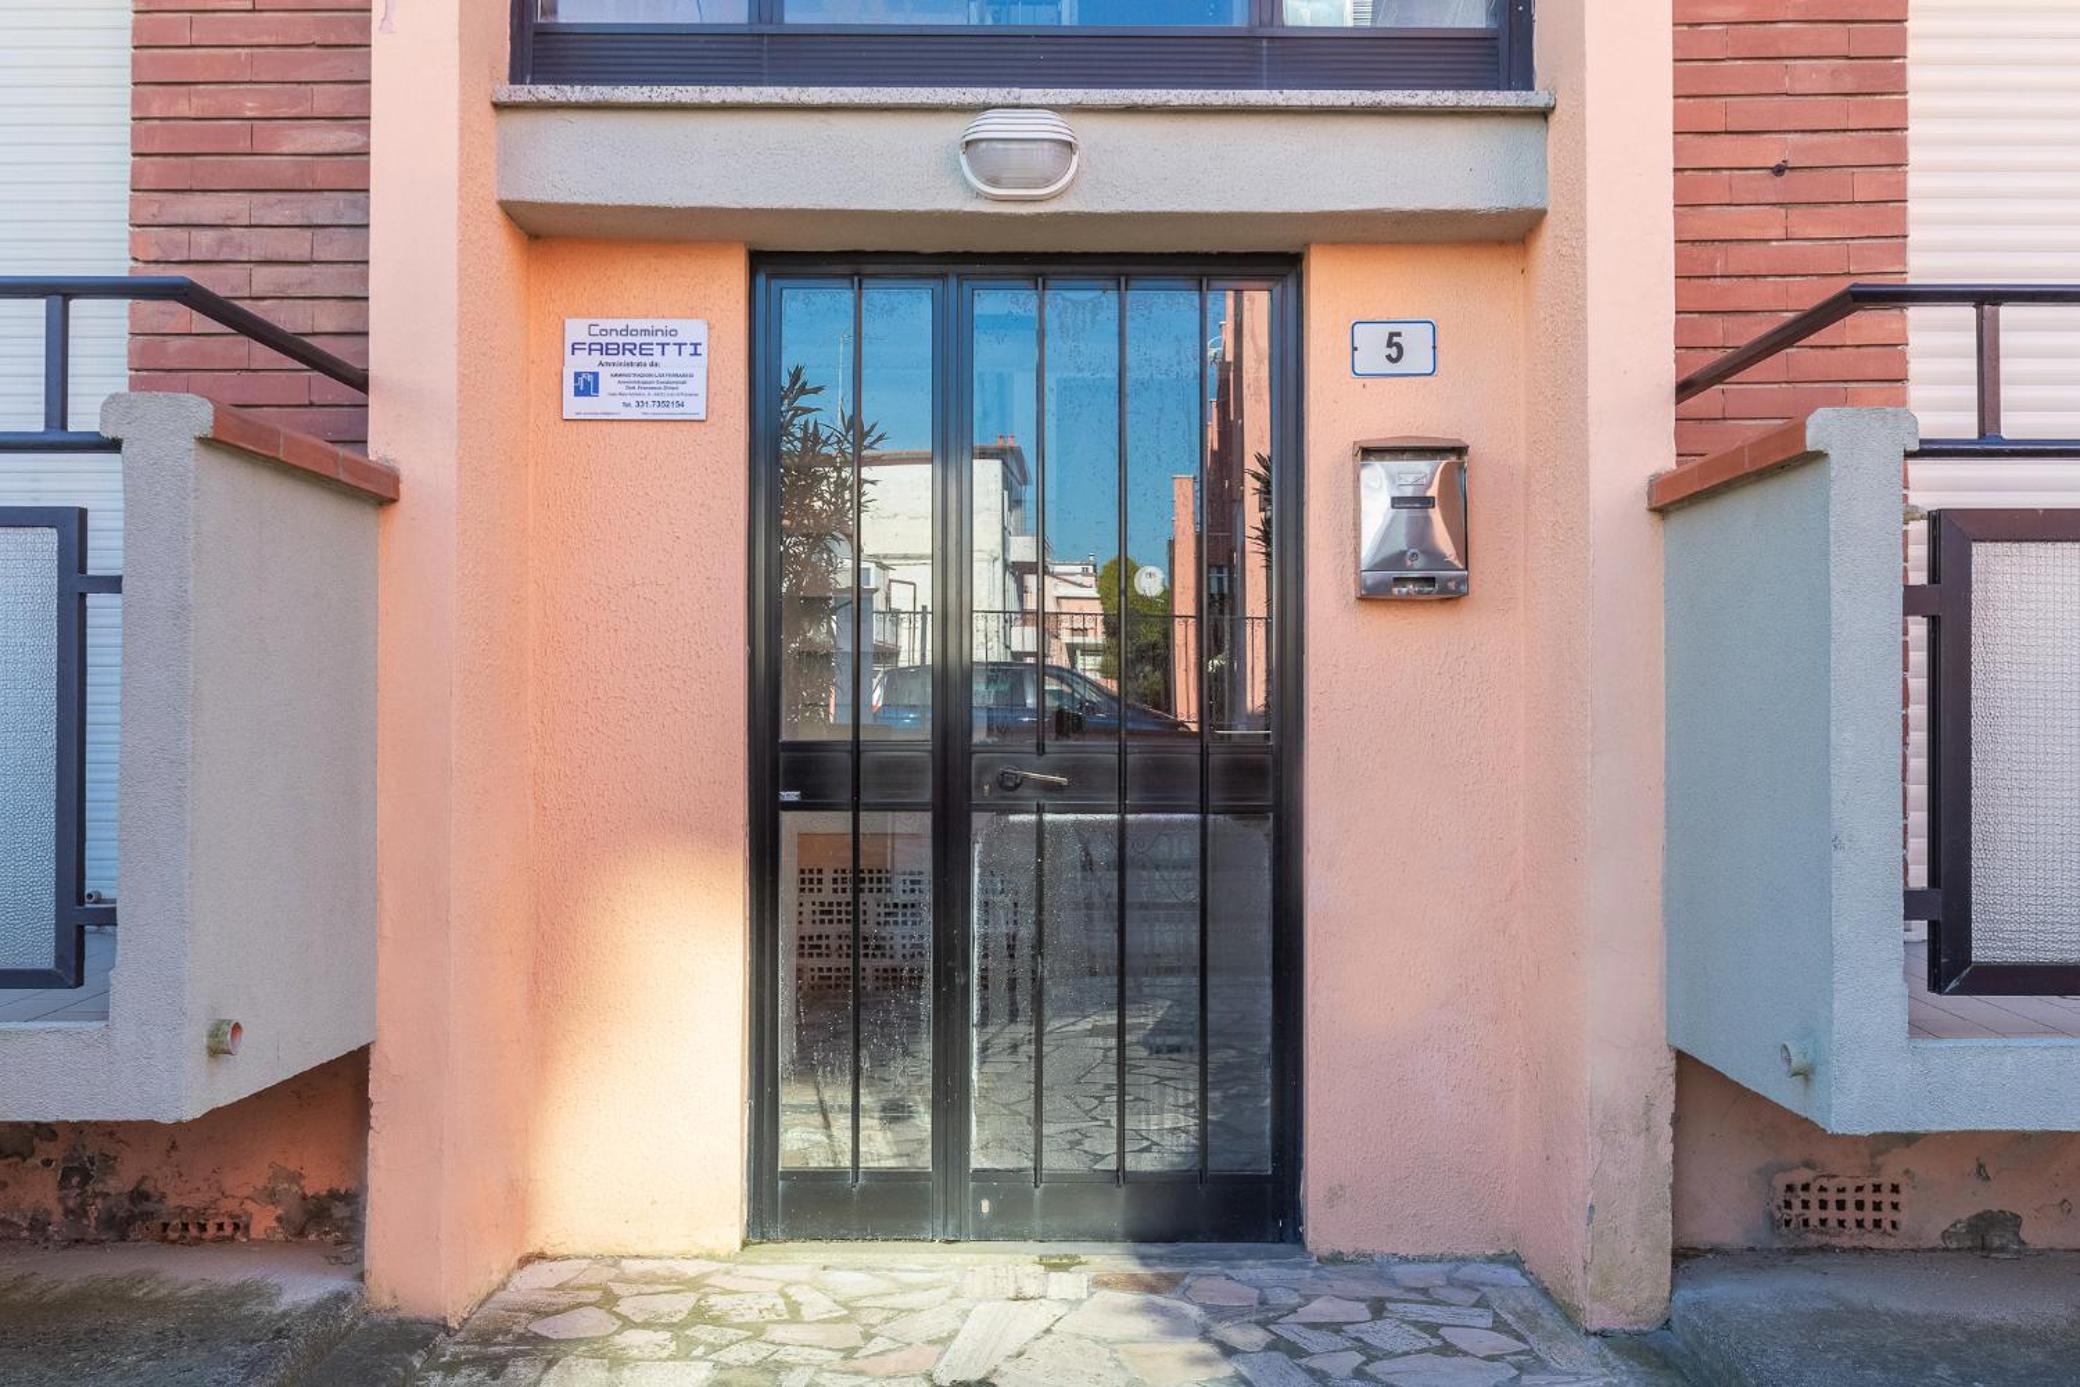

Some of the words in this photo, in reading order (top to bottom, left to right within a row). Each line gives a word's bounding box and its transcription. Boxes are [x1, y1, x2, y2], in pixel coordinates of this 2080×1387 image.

[588, 323, 678, 337] Condominio
[571, 342, 702, 357] FABRETTI
[1385, 331, 1404, 364] 5
